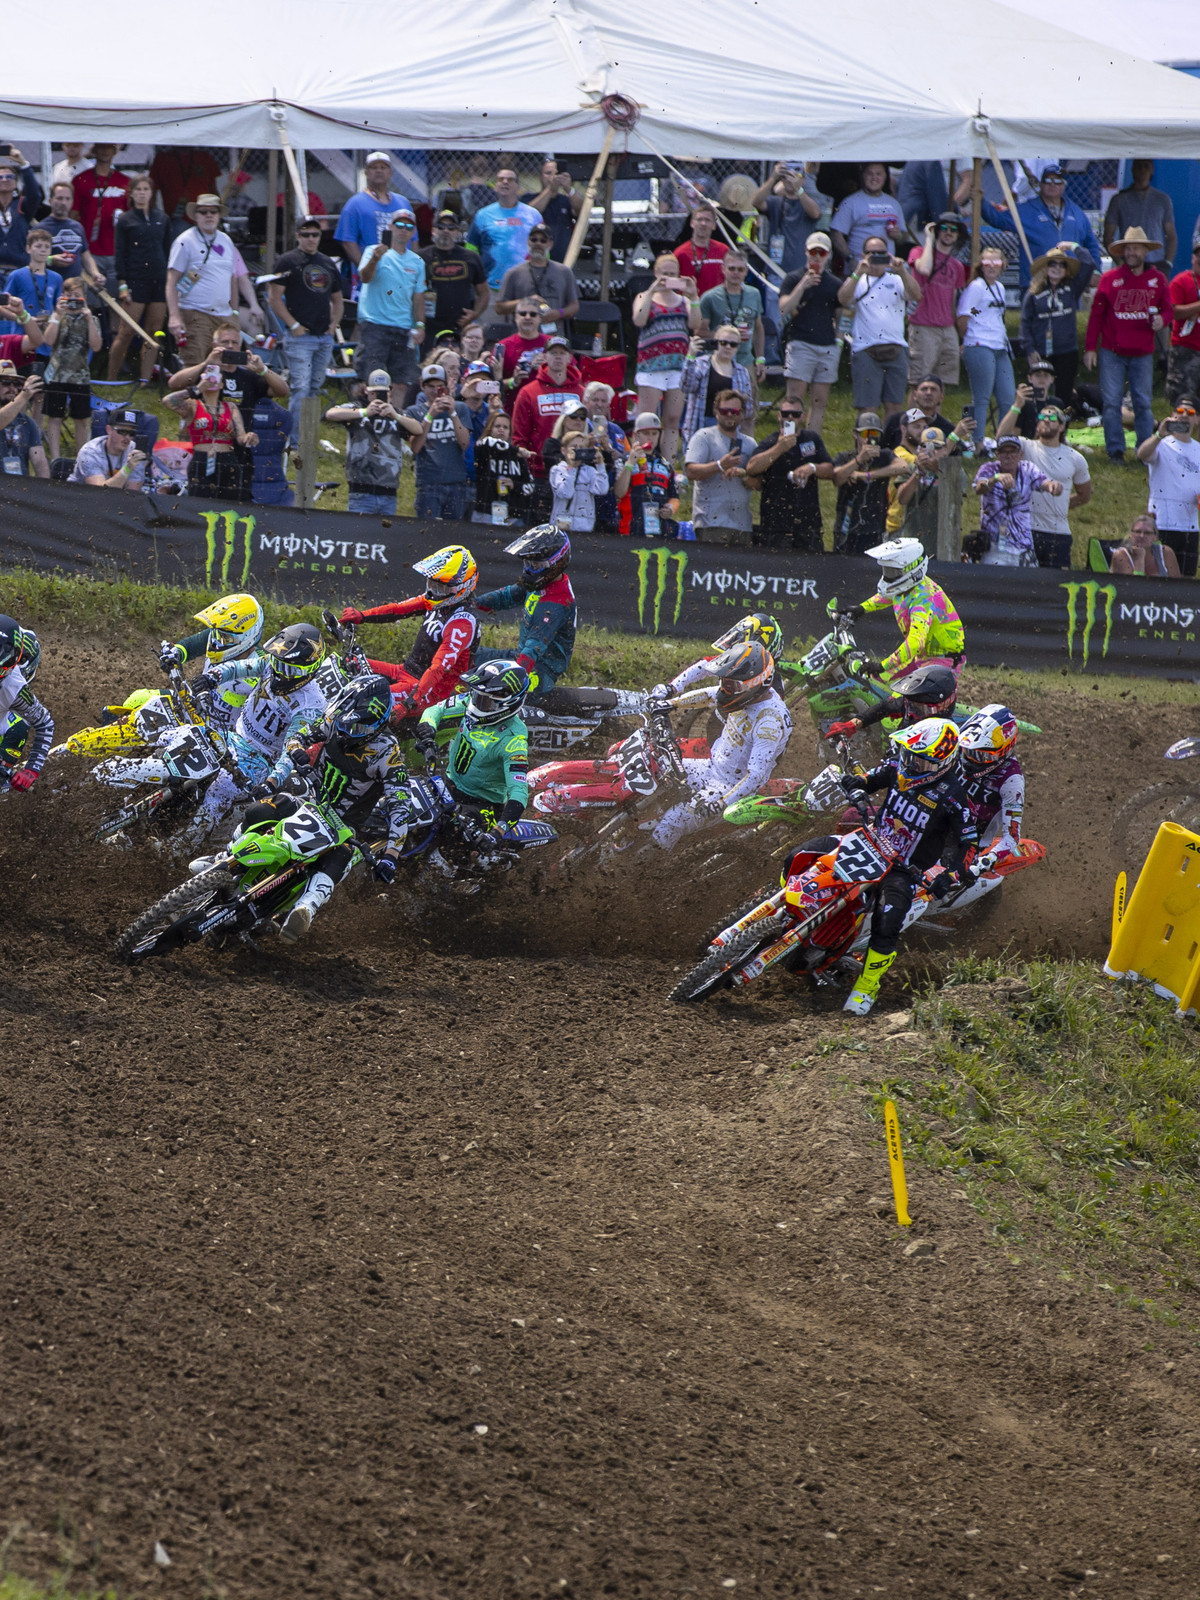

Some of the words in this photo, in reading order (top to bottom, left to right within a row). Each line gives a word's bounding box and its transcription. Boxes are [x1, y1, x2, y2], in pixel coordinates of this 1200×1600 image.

[278, 559, 368, 576] ENERGY
[710, 596, 799, 612] ENERGY
[1120, 601, 1200, 628] MONS
[1139, 628, 1196, 642] ENER
[255, 703, 289, 738] FLY
[166, 735, 209, 777] 12
[312, 810, 324, 823] LUCAS
[886, 788, 931, 829] THOR
[283, 813, 332, 854] 21
[836, 838, 885, 881] 222
[862, 838, 876, 853] LUCAS
[873, 850, 882, 860] OIL
[201, 909, 237, 936] DUNLOP
[890, 1118, 901, 1162] ACERBIS
